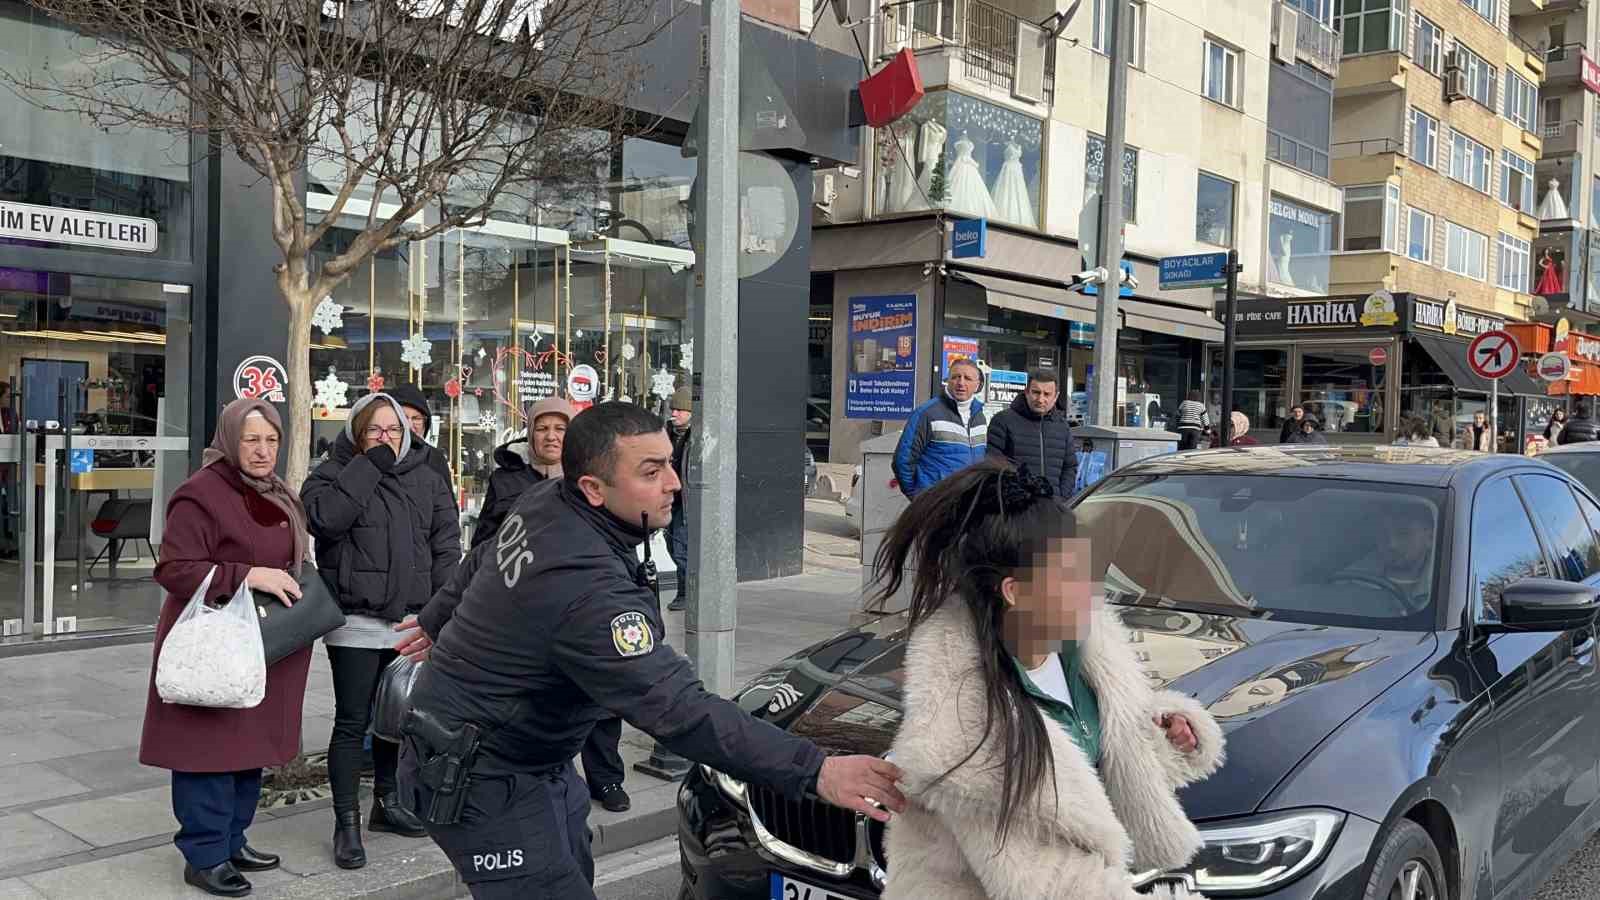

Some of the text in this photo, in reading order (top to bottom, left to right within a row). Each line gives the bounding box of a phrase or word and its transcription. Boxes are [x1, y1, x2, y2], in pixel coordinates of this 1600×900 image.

[30, 213, 54, 232] EV
[60, 217, 147, 243] ALETLERİ
[955, 230, 979, 241] beko
[1163, 256, 1215, 269] BOYACILAR
[1287, 302, 1357, 325] HARİKA
[1415, 302, 1443, 328] HARİKA
[241, 366, 276, 400] 36
